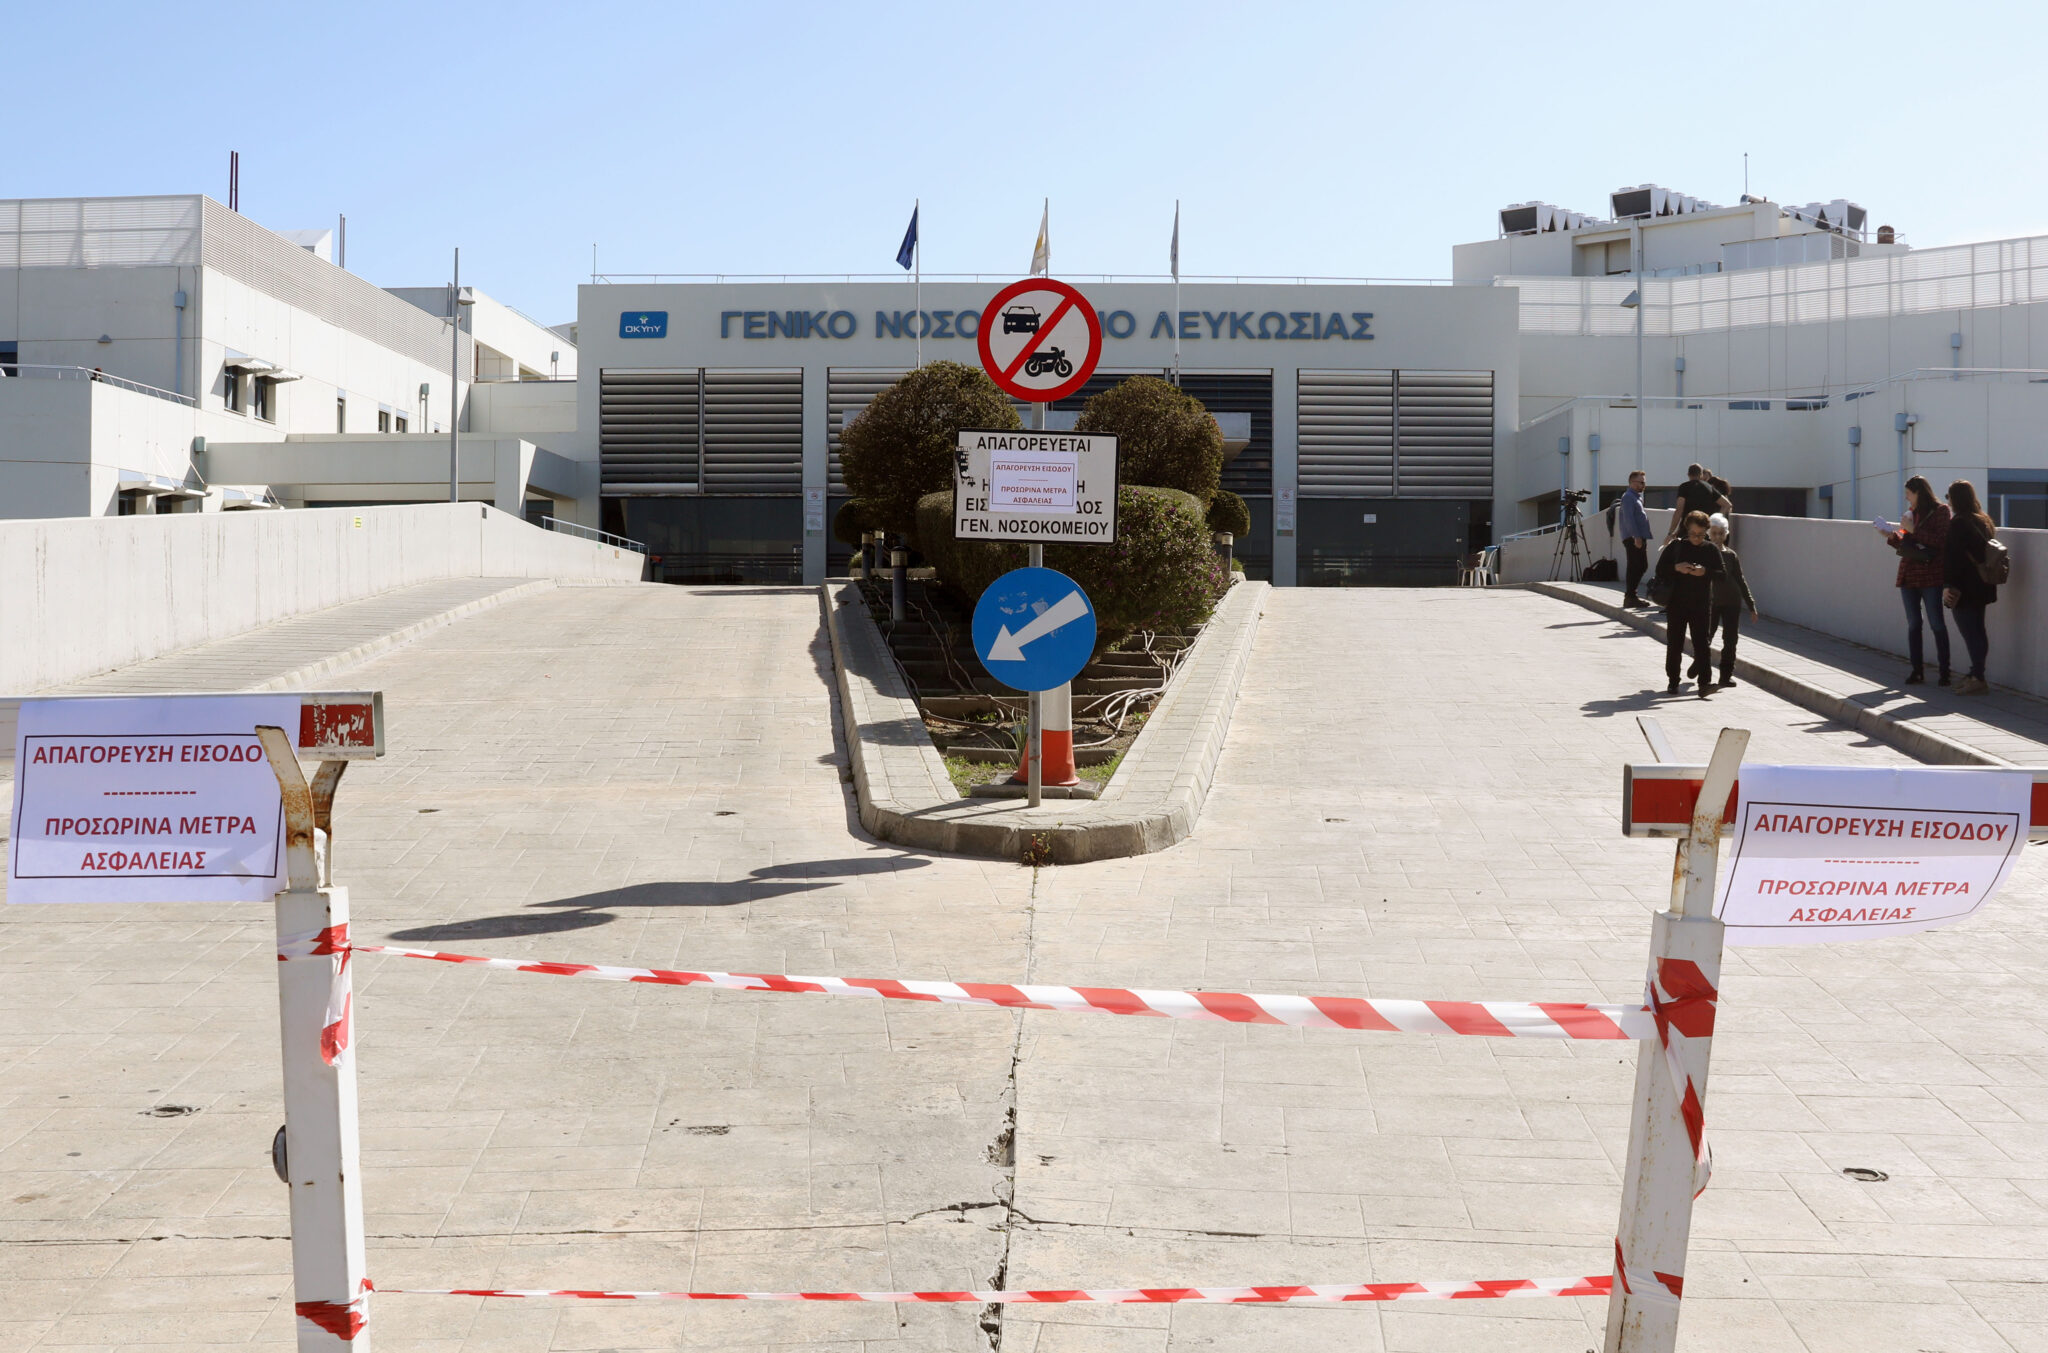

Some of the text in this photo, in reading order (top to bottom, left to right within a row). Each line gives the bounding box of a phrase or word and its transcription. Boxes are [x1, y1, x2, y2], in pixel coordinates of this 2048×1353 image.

[720, 310, 857, 339] ΓΕΝΙΚΟ
[1151, 311, 1375, 340] ΛΕΥΚΩΣΙΑΣ
[977, 436, 1091, 452] ΑΠΑΓΟΡΕΥΕΤΑΙ
[996, 464, 1072, 473] ΑΠΑΓΟΡΕΥΣΗ ΕΙΣΟΔΟΥ
[1000, 485, 1042, 495] ΠΡΟΣΩΡΙΝΑ
[1043, 487, 1067, 495] ΜΕΤΡΑ
[960, 518, 1109, 536] ΓΕΝ. ΝΟΣΟΚΟΜΕΙΟΥ
[33, 744, 267, 764] ΑΠΑΓΟΡΕΥΣΗ ΕΙΣΟΔΟ
[45, 816, 257, 836] ΠΡΟΣΩΡΙΝΑ ΜΕΤΡΑ
[1754, 813, 2009, 842] ΑΠΑΓΟΡΕΥΣΗ ΕΙΣΟΔΟΥ
[81, 851, 207, 871] ΑΣΦΑΛΕΙΑΣ
[1757, 879, 1971, 897] ΠΡΟΣΩΡΙΝΑ ΜΕΤΡΑ
[1788, 907, 1917, 923] ΑΣΦΑΛΕΙΑΣ
